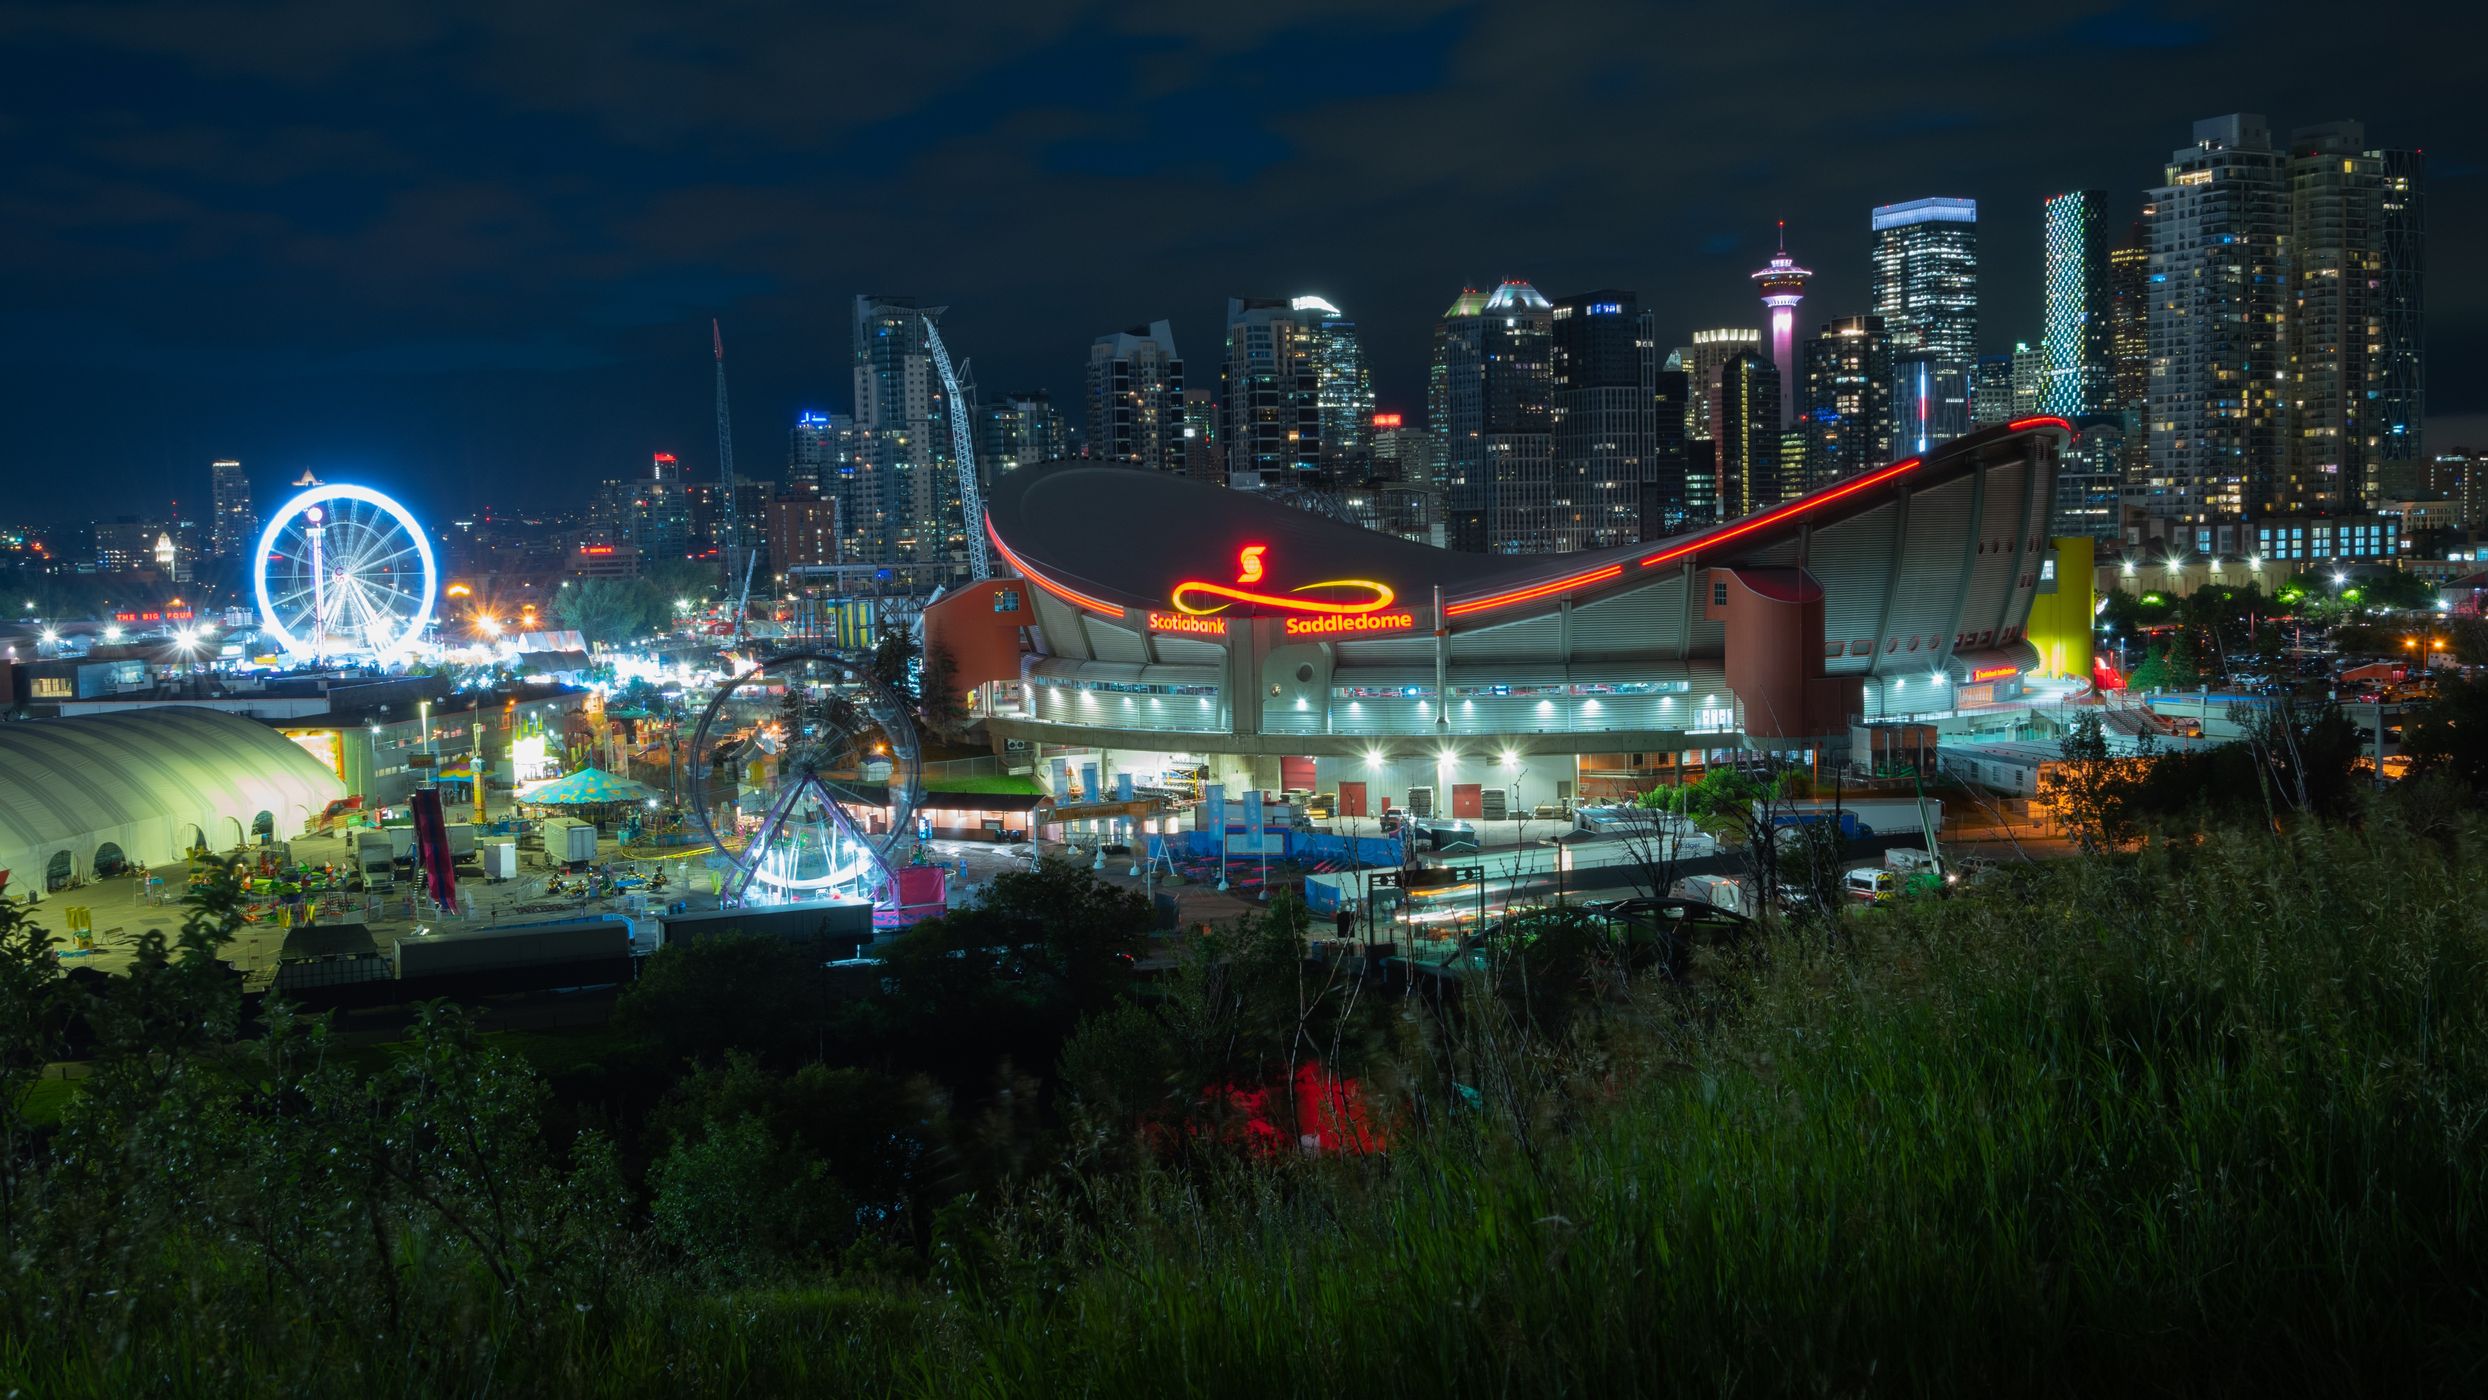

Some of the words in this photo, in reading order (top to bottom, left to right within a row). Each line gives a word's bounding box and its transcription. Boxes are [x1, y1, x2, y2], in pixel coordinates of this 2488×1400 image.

[116, 613, 136, 621] THE
[167, 611, 192, 620] FOUR
[1150, 613, 1226, 635] Scotiabank
[1286, 612, 1413, 635] Saddledome
